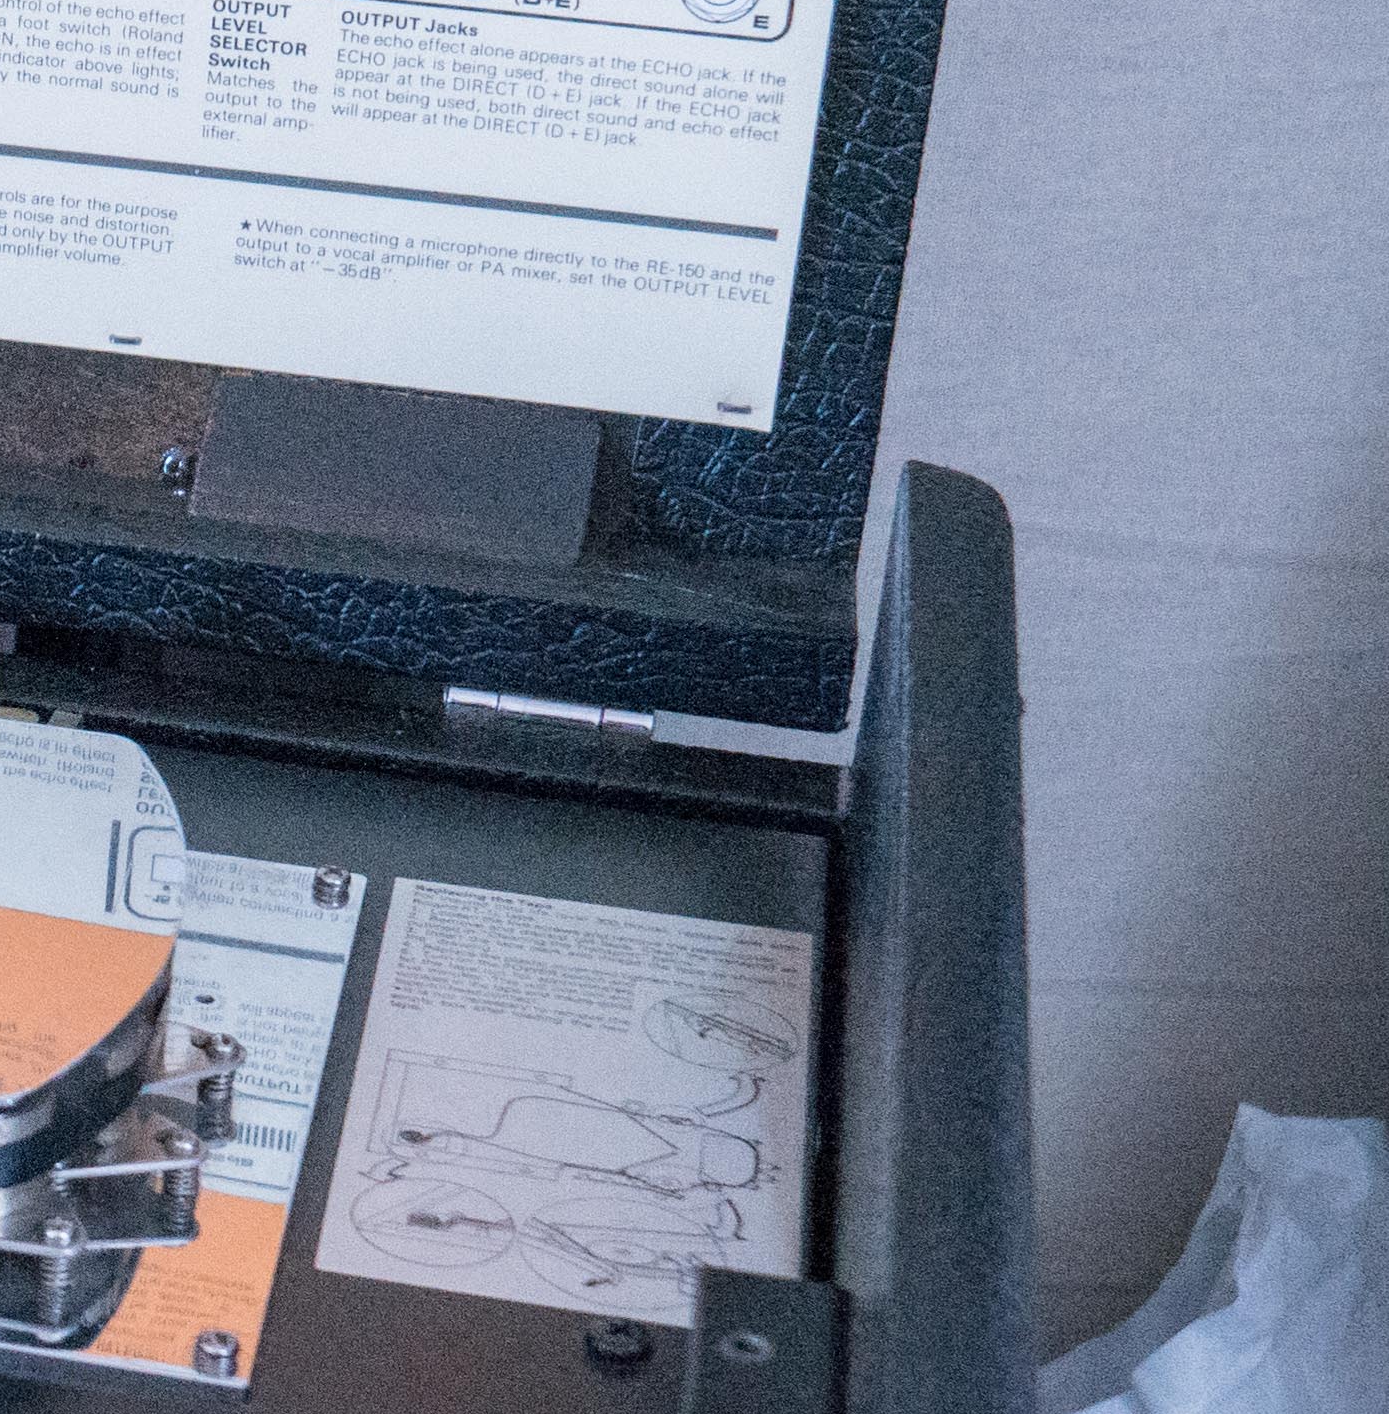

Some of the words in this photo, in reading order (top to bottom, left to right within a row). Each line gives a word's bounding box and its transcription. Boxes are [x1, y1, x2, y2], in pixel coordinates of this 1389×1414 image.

[210, 15, 267, 35] LEVEL
[340, 9, 421, 31] OUTPUT
[423, 18, 478, 37] Jacks
[752, 14, 769, 30] E
[208, 33, 307, 57] SELECTOR
[207, 51, 271, 71] Switch
